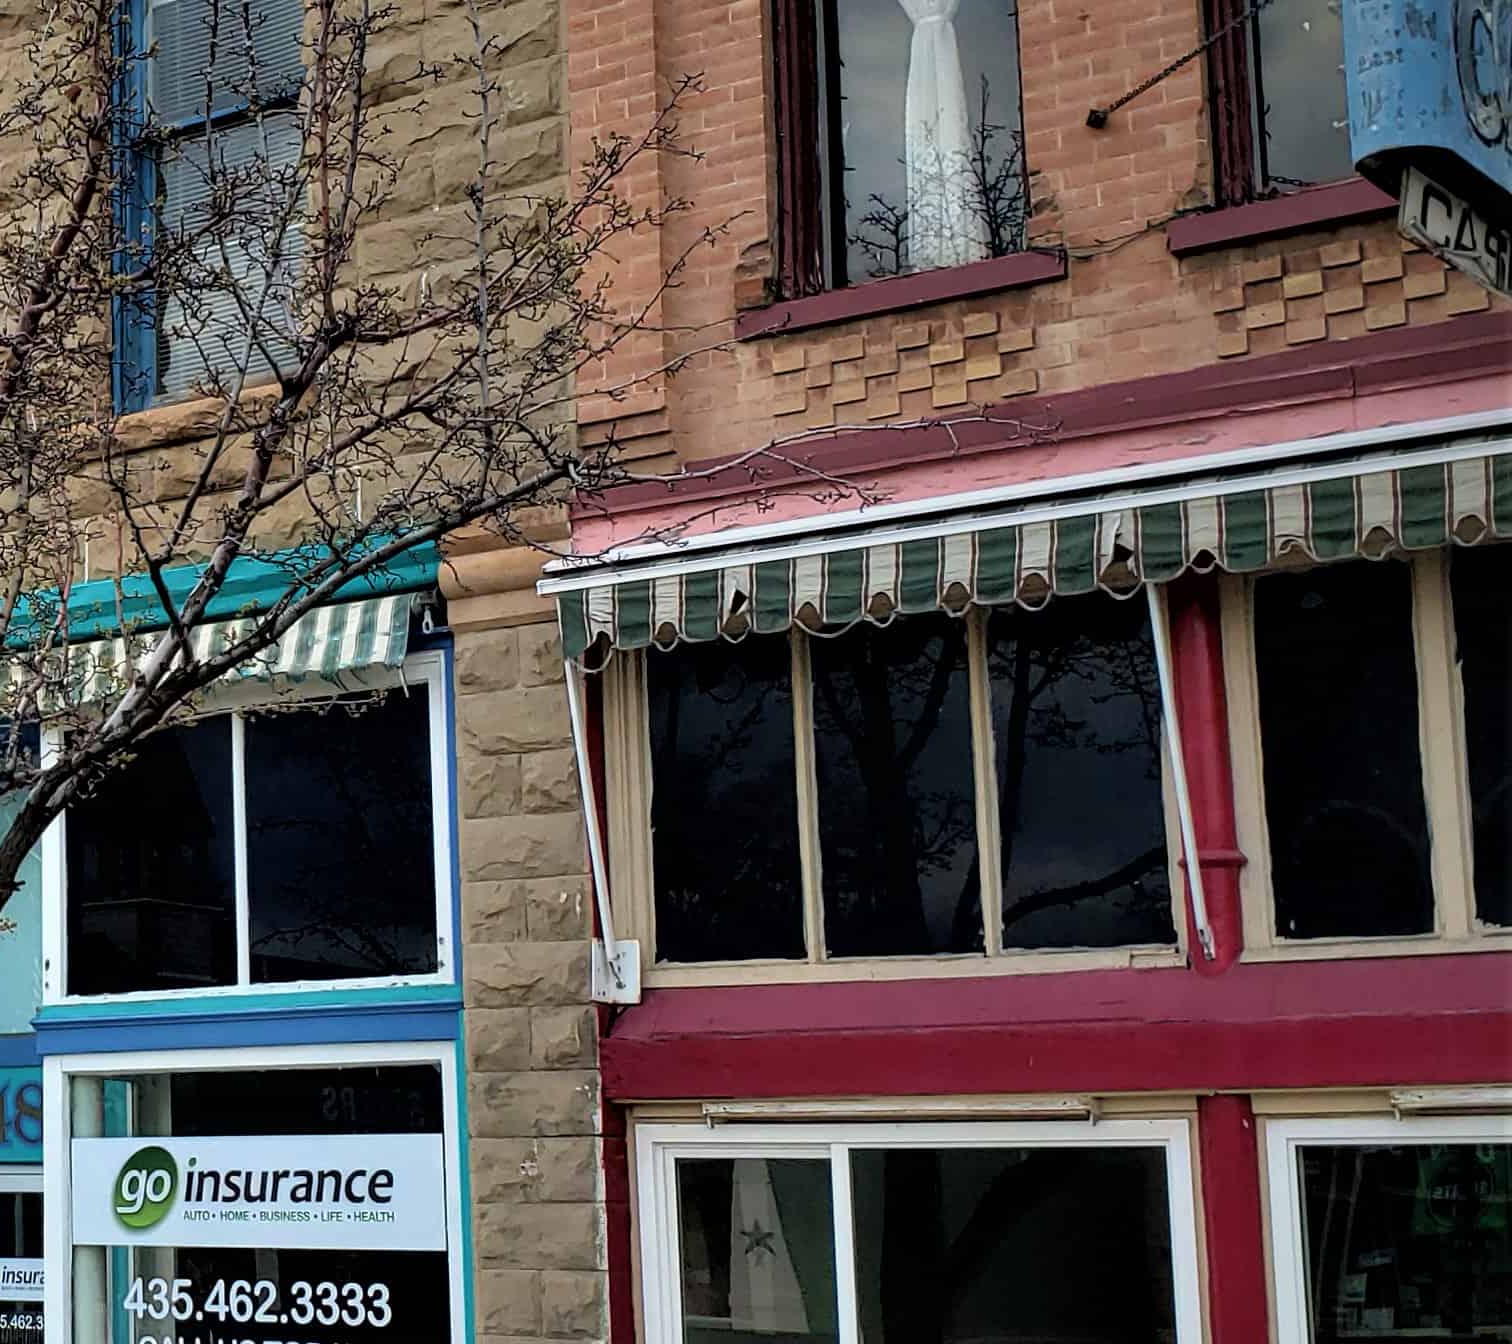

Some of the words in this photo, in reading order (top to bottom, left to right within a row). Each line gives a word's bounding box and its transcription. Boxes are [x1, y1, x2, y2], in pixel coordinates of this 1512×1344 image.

[116, 1168, 171, 1214] go
[184, 1156, 394, 1204] insurance
[183, 1211, 210, 1222] AUTO
[220, 1211, 249, 1222] HOME
[259, 1211, 310, 1222] BUSINESS
[321, 1211, 343, 1222] LIFE
[353, 1211, 395, 1222] HEALTH
[123, 1277, 392, 1327] 435.462.3333
